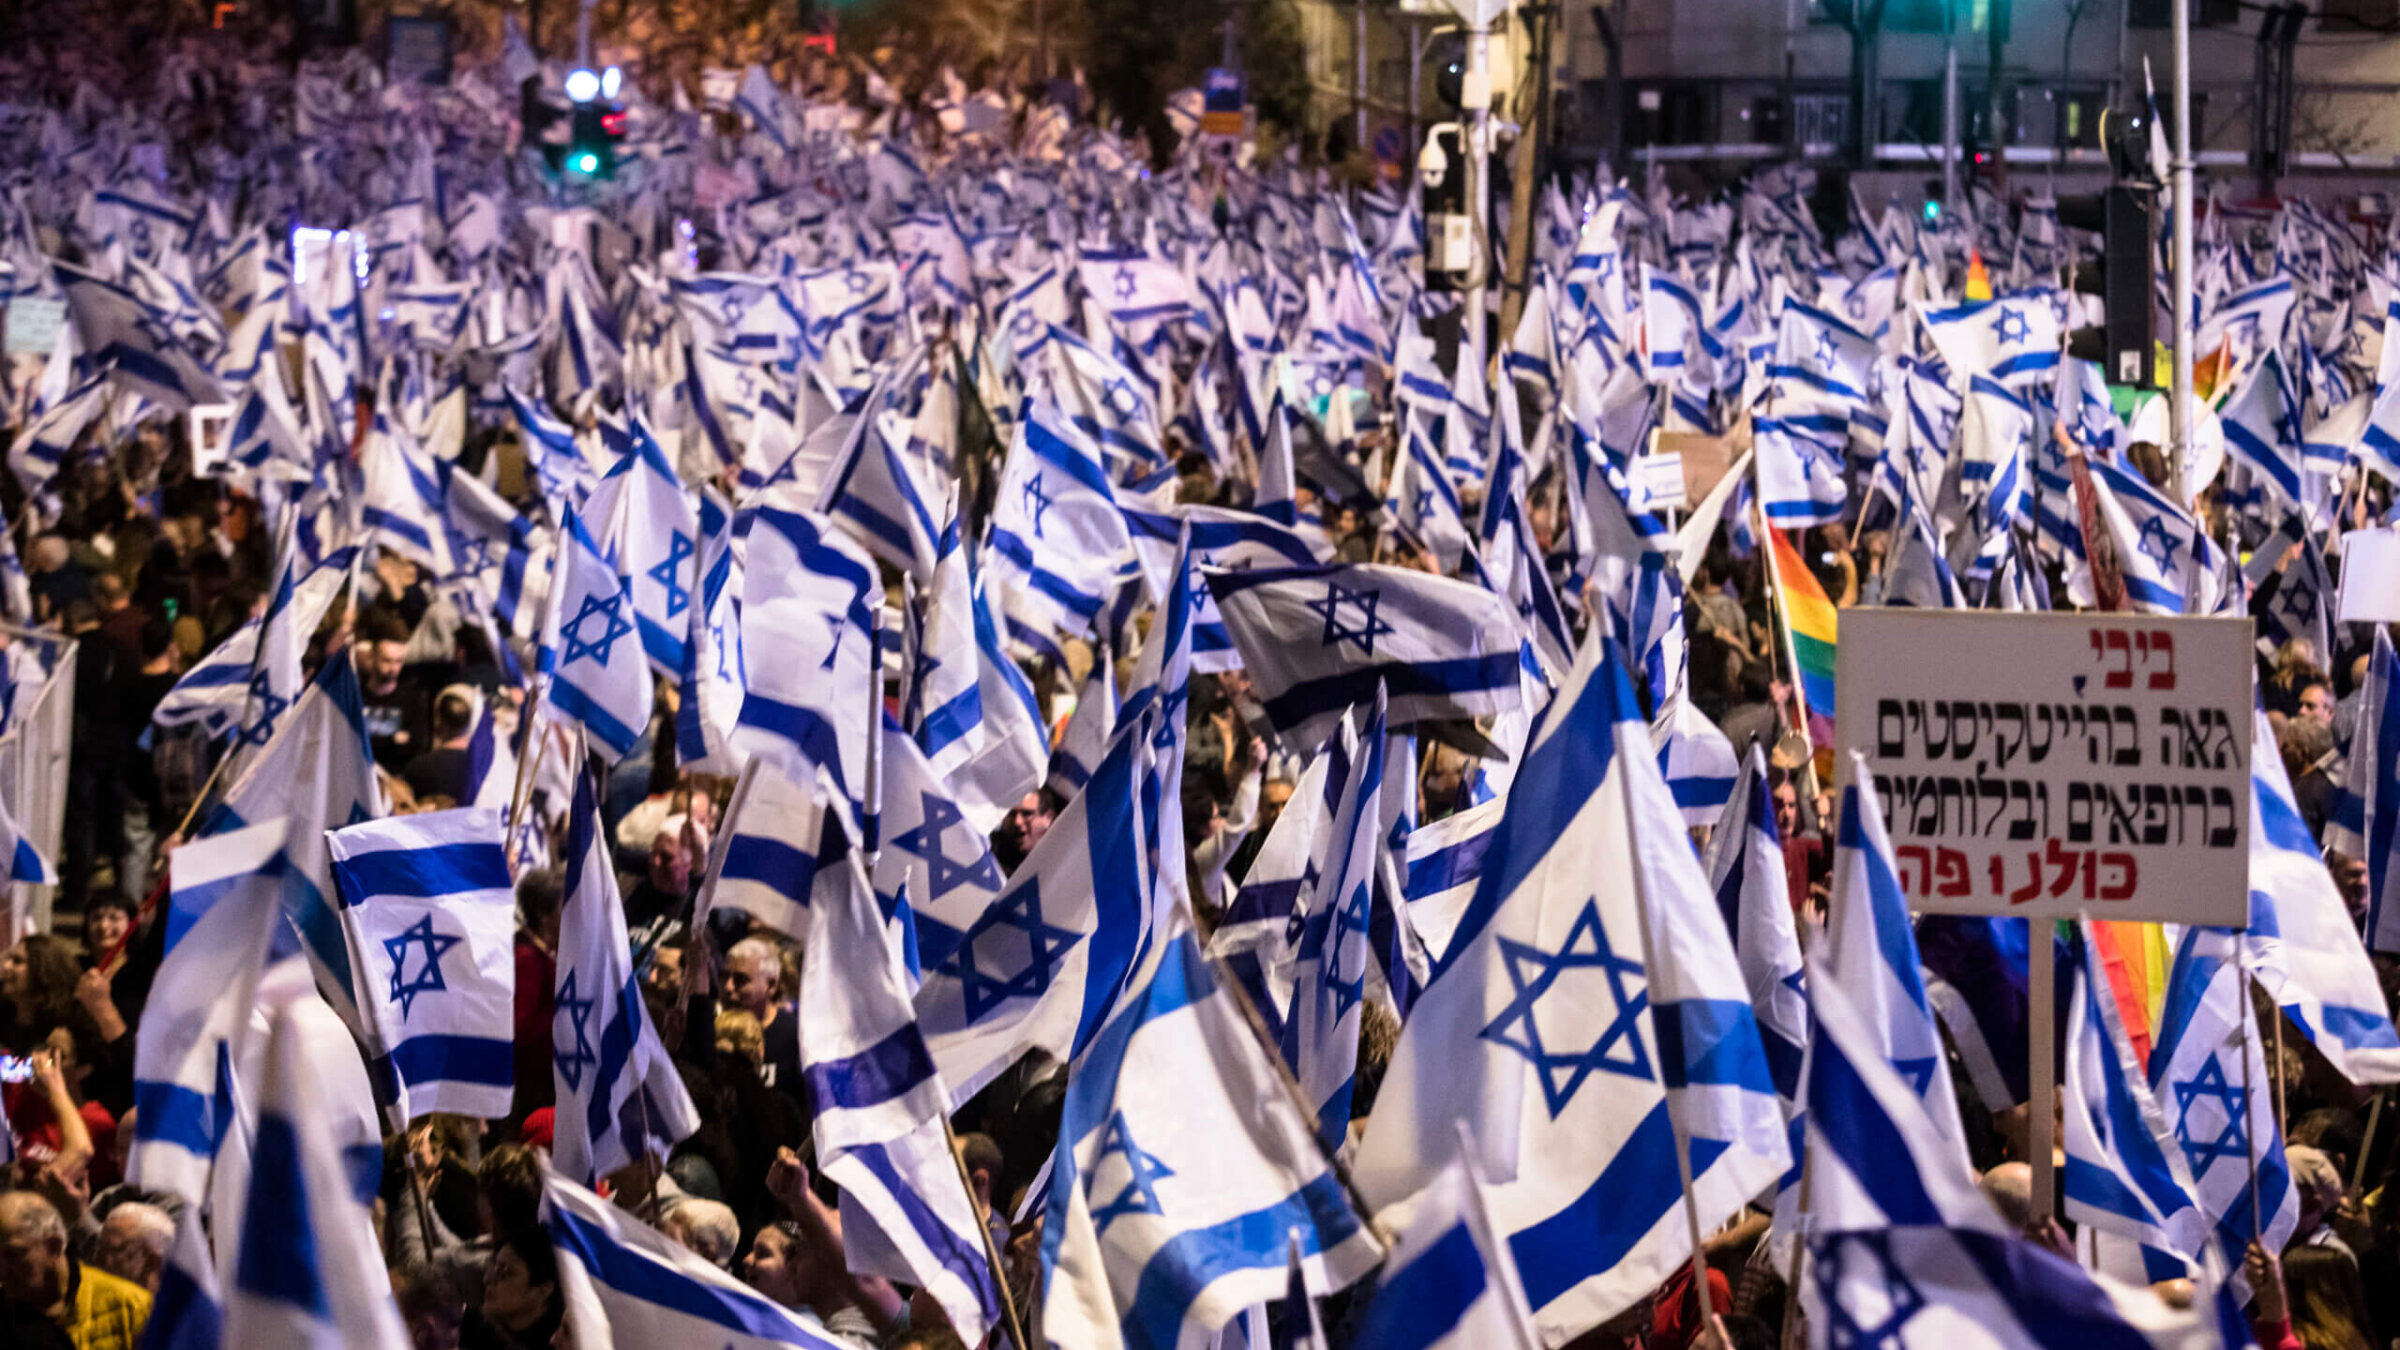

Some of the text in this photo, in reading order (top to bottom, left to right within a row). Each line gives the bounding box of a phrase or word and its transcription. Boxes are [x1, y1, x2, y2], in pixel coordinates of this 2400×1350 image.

[2089, 628, 2176, 690] ביבי
[1877, 698, 2242, 771] גאה בהייטקיסטים
[2067, 781, 2239, 849] ברופאים
[1896, 836, 2139, 905] כולנו פה
